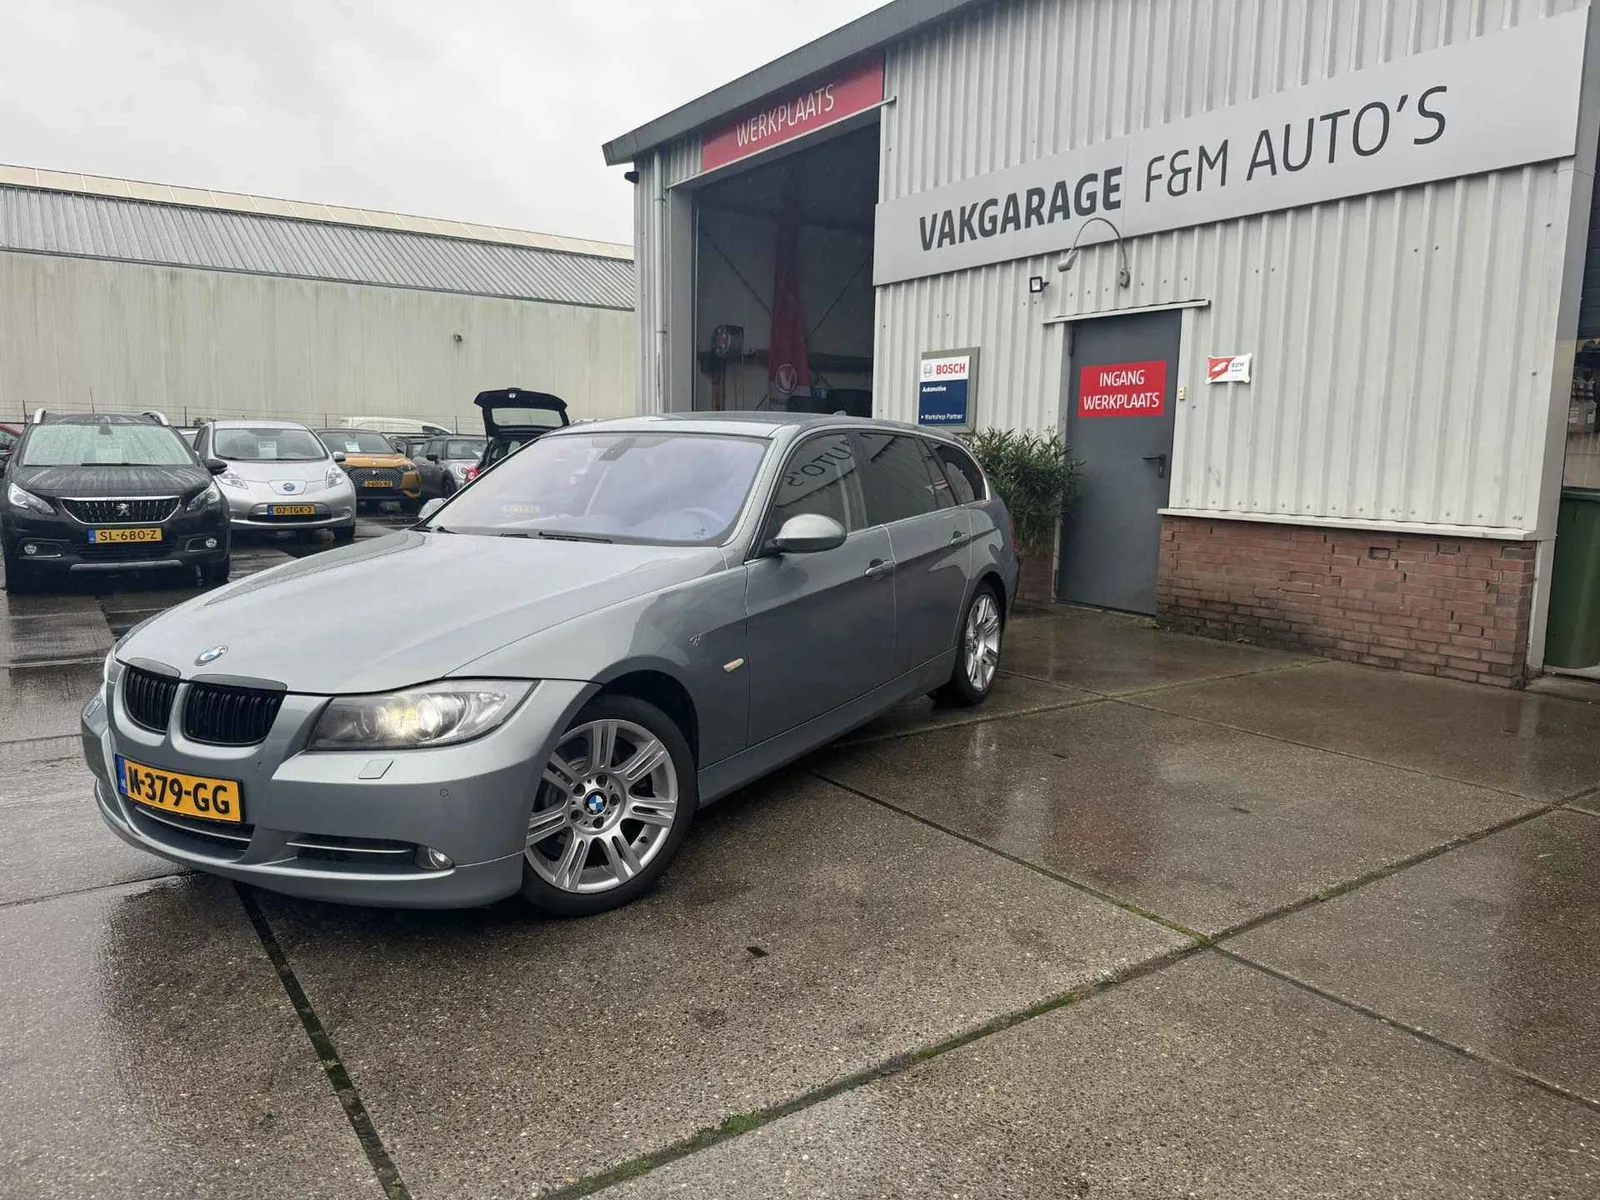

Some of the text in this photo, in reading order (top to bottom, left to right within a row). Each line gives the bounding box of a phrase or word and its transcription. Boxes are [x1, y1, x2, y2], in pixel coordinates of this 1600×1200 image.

[736, 83, 834, 147] WERKPLAATS
[919, 85, 1448, 251] VAKGARAGE F&M AUTO'S
[936, 363, 966, 374] BOSCH
[1099, 369, 1145, 387] INGANG
[1083, 392, 1160, 410] WERKPLAATS
[99, 530, 158, 541] SL-680-Z
[128, 766, 231, 815] N-379-GG
